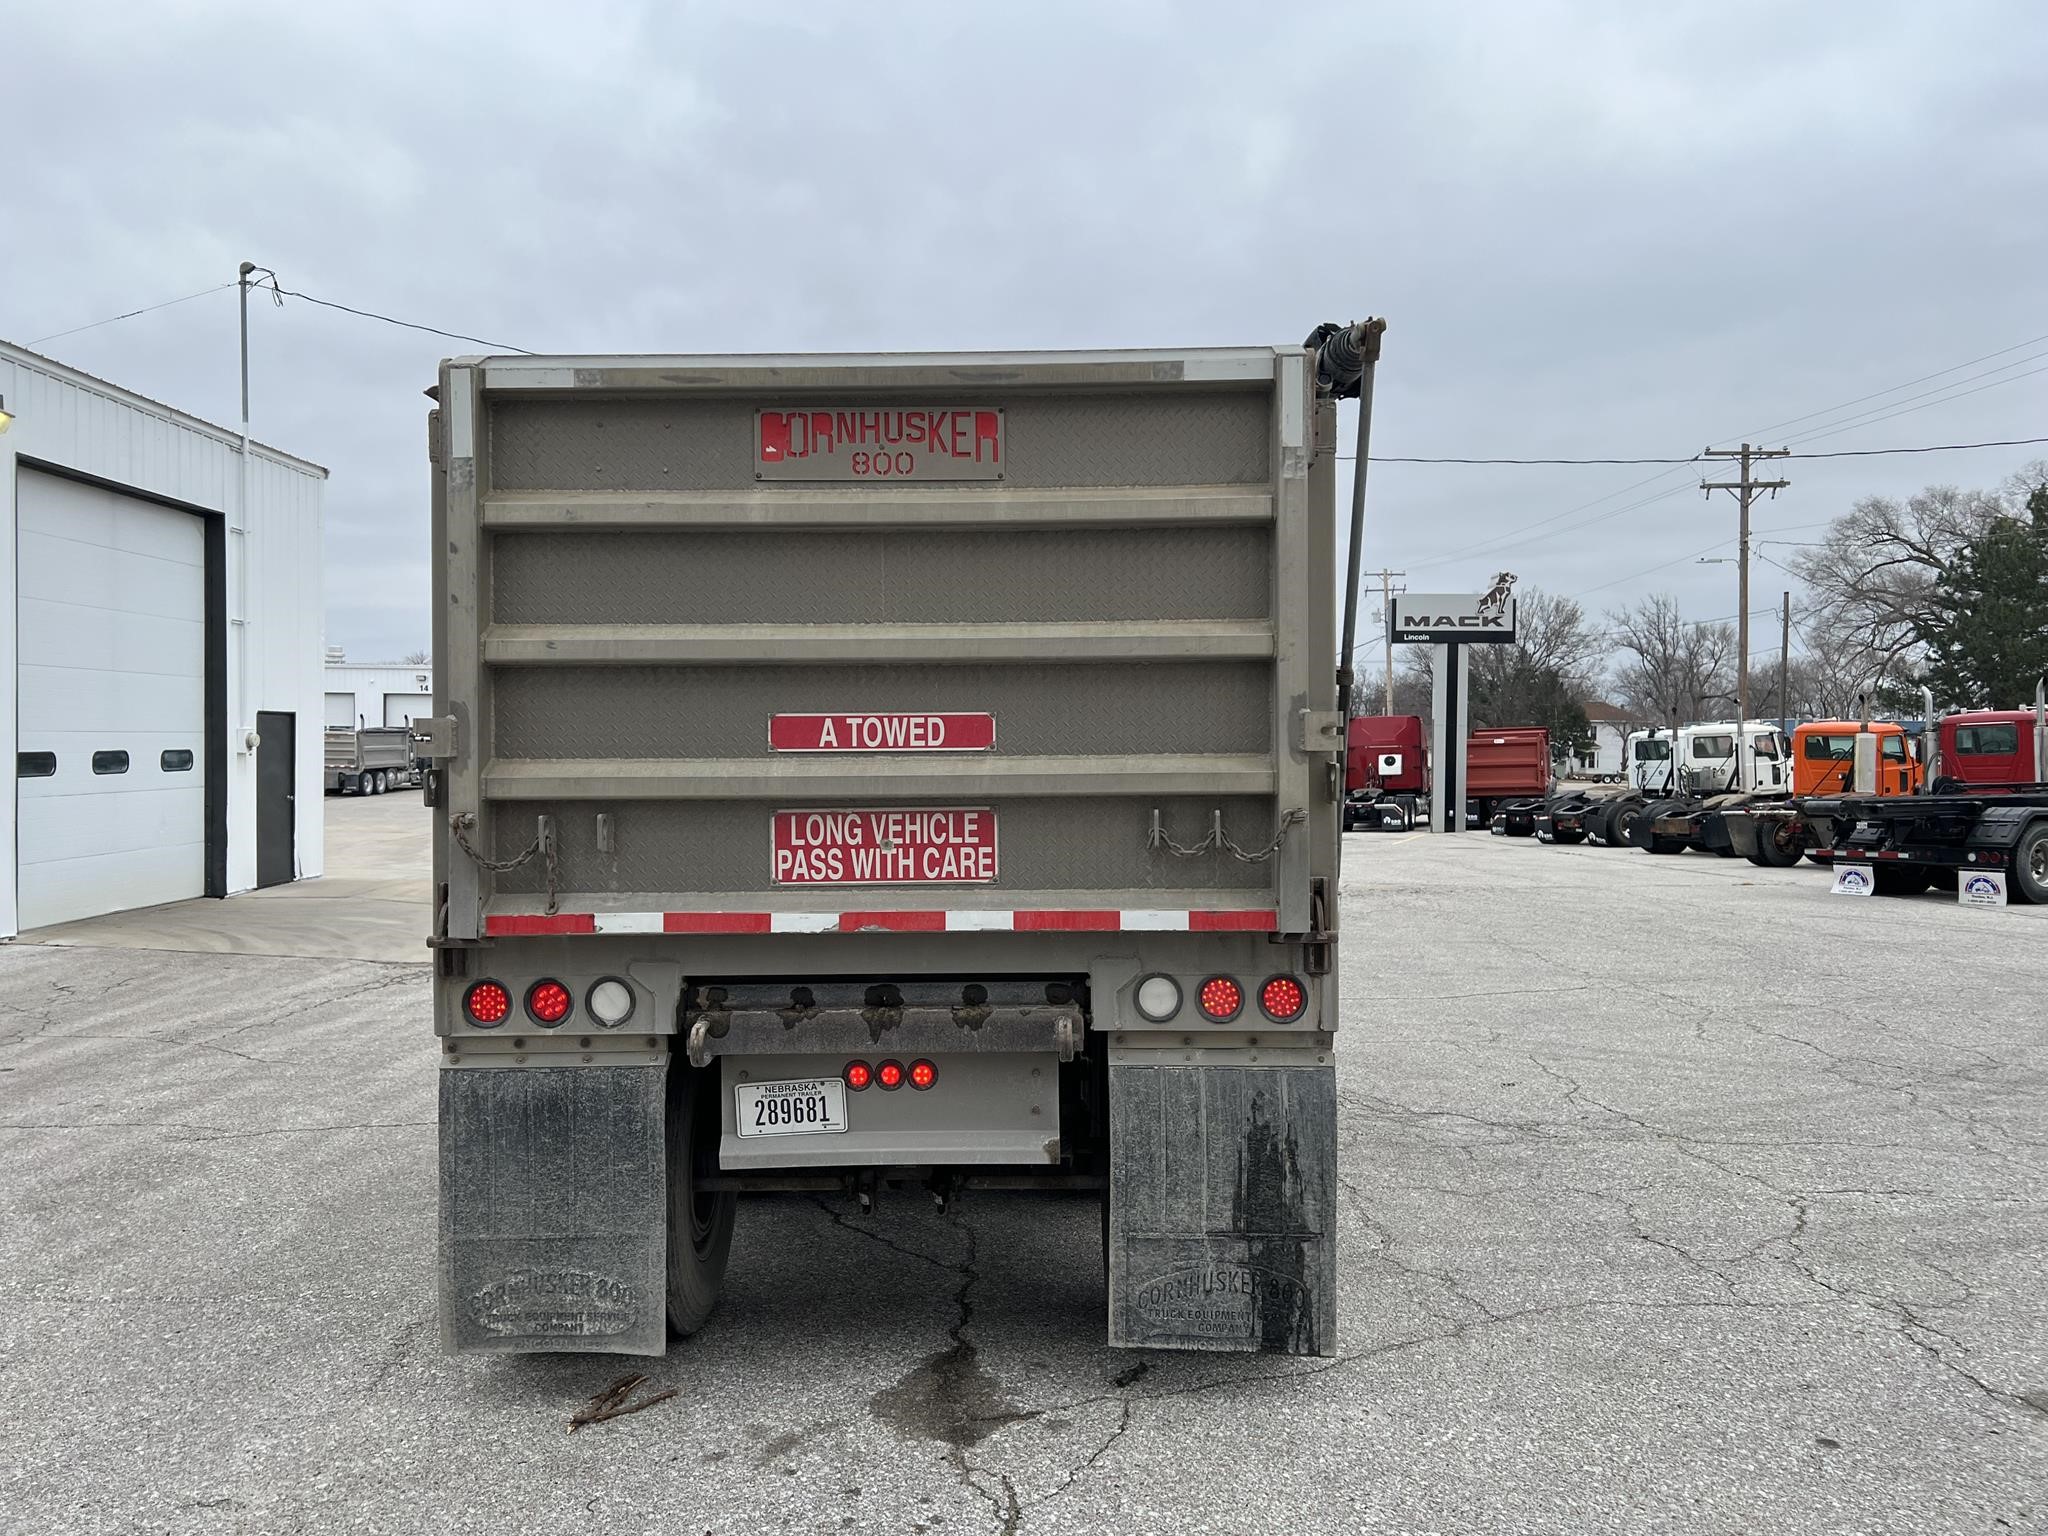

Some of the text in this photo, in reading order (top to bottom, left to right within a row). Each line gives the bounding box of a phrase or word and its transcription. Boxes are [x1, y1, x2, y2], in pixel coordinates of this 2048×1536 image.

[761, 412, 998, 462] CORNHUSKER
[852, 452, 914, 475] 800
[1404, 616, 1504, 627] MACK
[819, 717, 945, 747] A TOWED
[790, 813, 979, 846] LONG VEHICLE
[777, 847, 993, 880] PASS WITH CARE
[761, 1092, 796, 1100] PERMANENT
[765, 1083, 817, 1094] NEBRASKA
[755, 1095, 830, 1126] 289681
[1138, 1270, 1262, 1310] CORNHUSKER
[1147, 1309, 1185, 1320] TRUCK
[1187, 1310, 1252, 1322] EQUIPMENT
